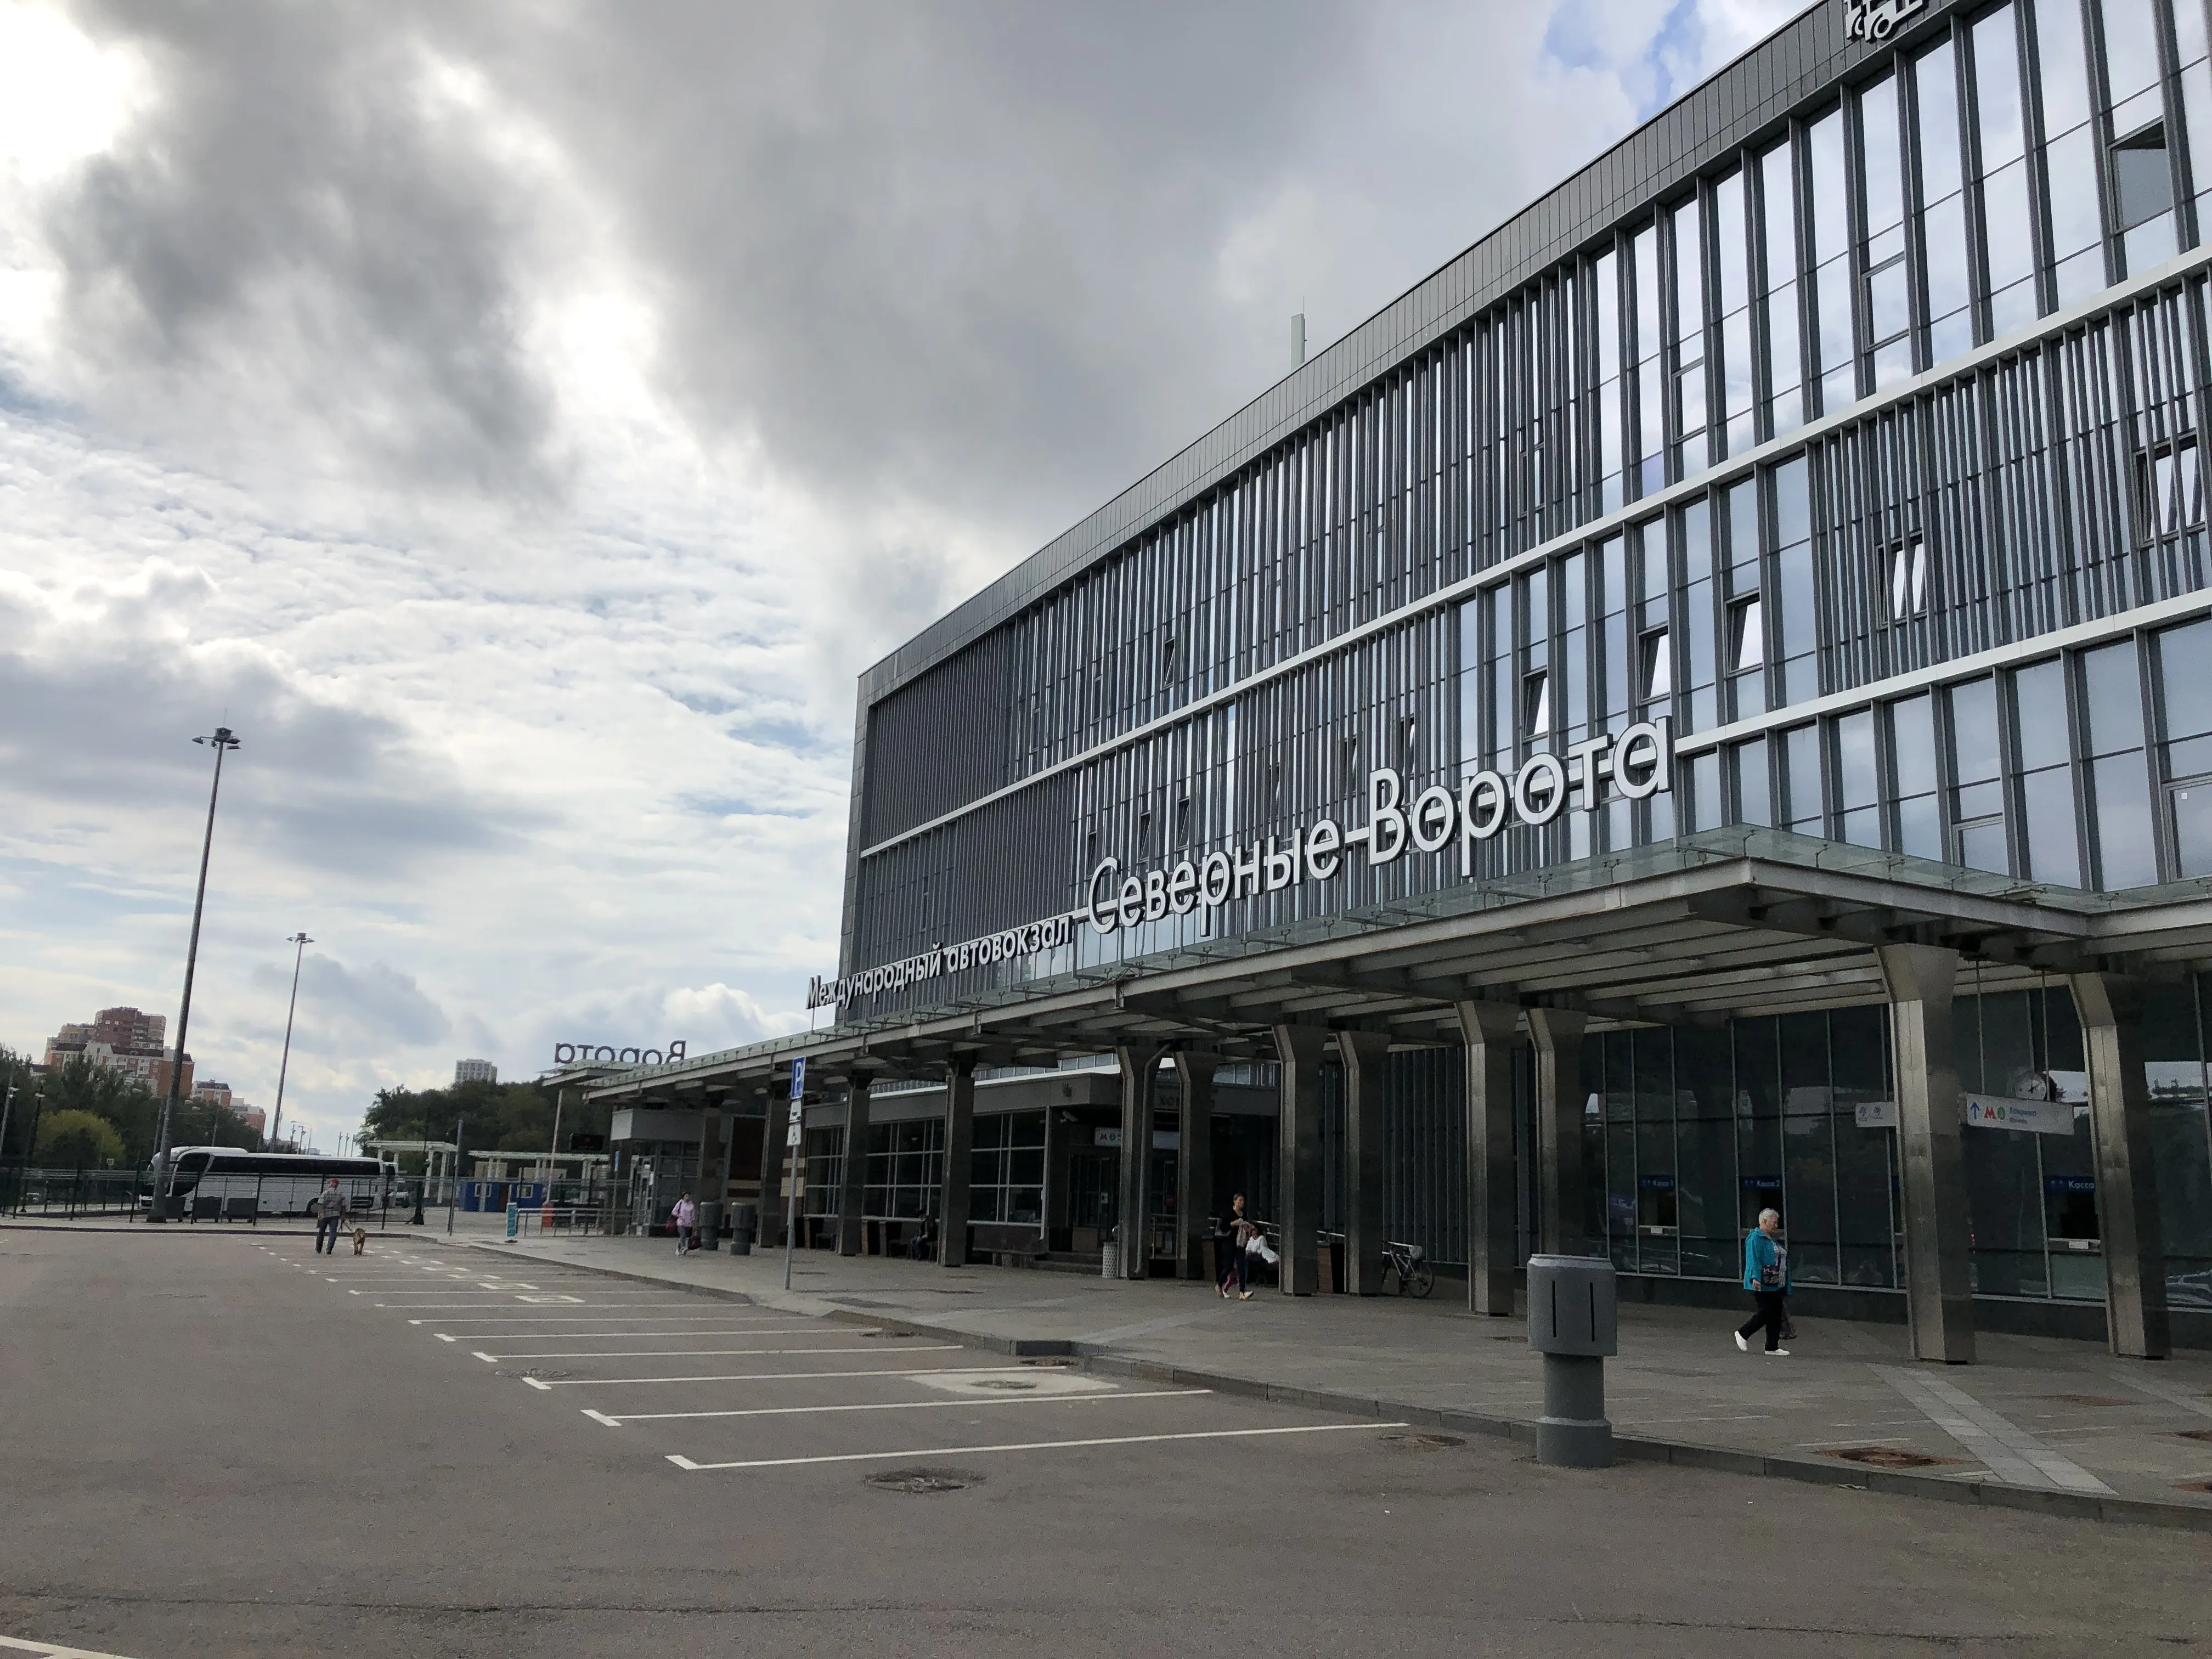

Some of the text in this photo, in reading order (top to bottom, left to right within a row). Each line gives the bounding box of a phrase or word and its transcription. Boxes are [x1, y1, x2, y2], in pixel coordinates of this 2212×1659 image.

[806, 716, 1674, 1009] Международный автовокзал Северные Ворота
[794, 1062, 803, 1095] P
[2068, 1180, 2095, 1189] Касса
